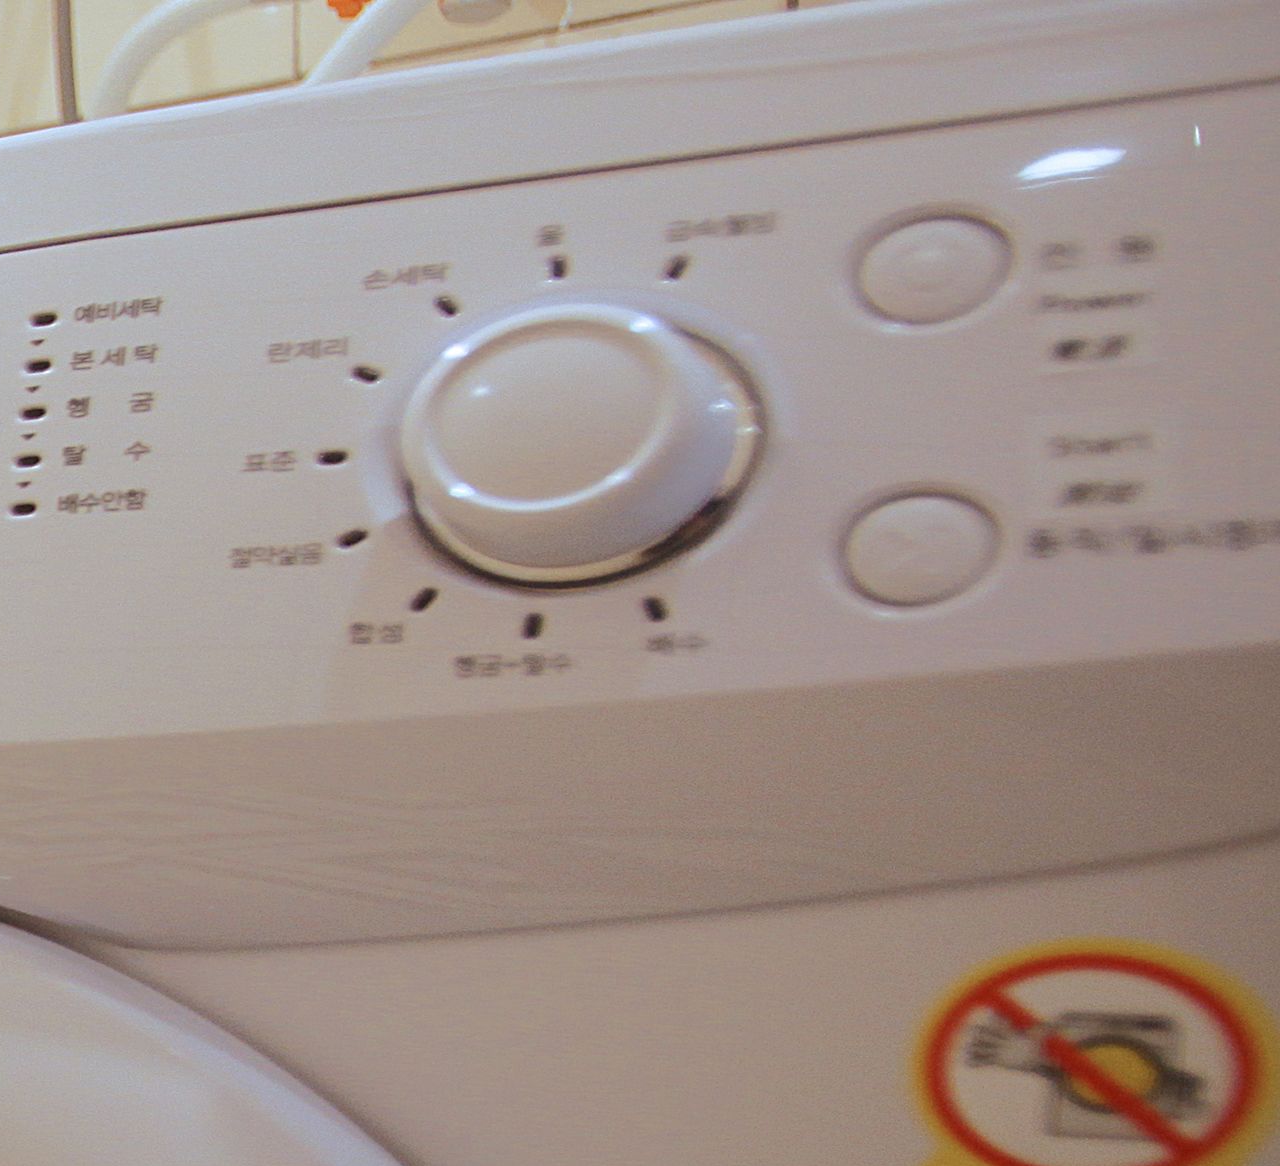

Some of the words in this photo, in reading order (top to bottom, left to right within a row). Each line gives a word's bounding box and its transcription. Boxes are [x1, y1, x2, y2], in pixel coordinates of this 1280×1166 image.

[362, 261, 451, 290] 손세탁
[74, 296, 164, 324] 예비세탁
[266, 336, 349, 364] 란제리
[242, 450, 296, 473] 표준
[57, 487, 148, 513] 배수안함
